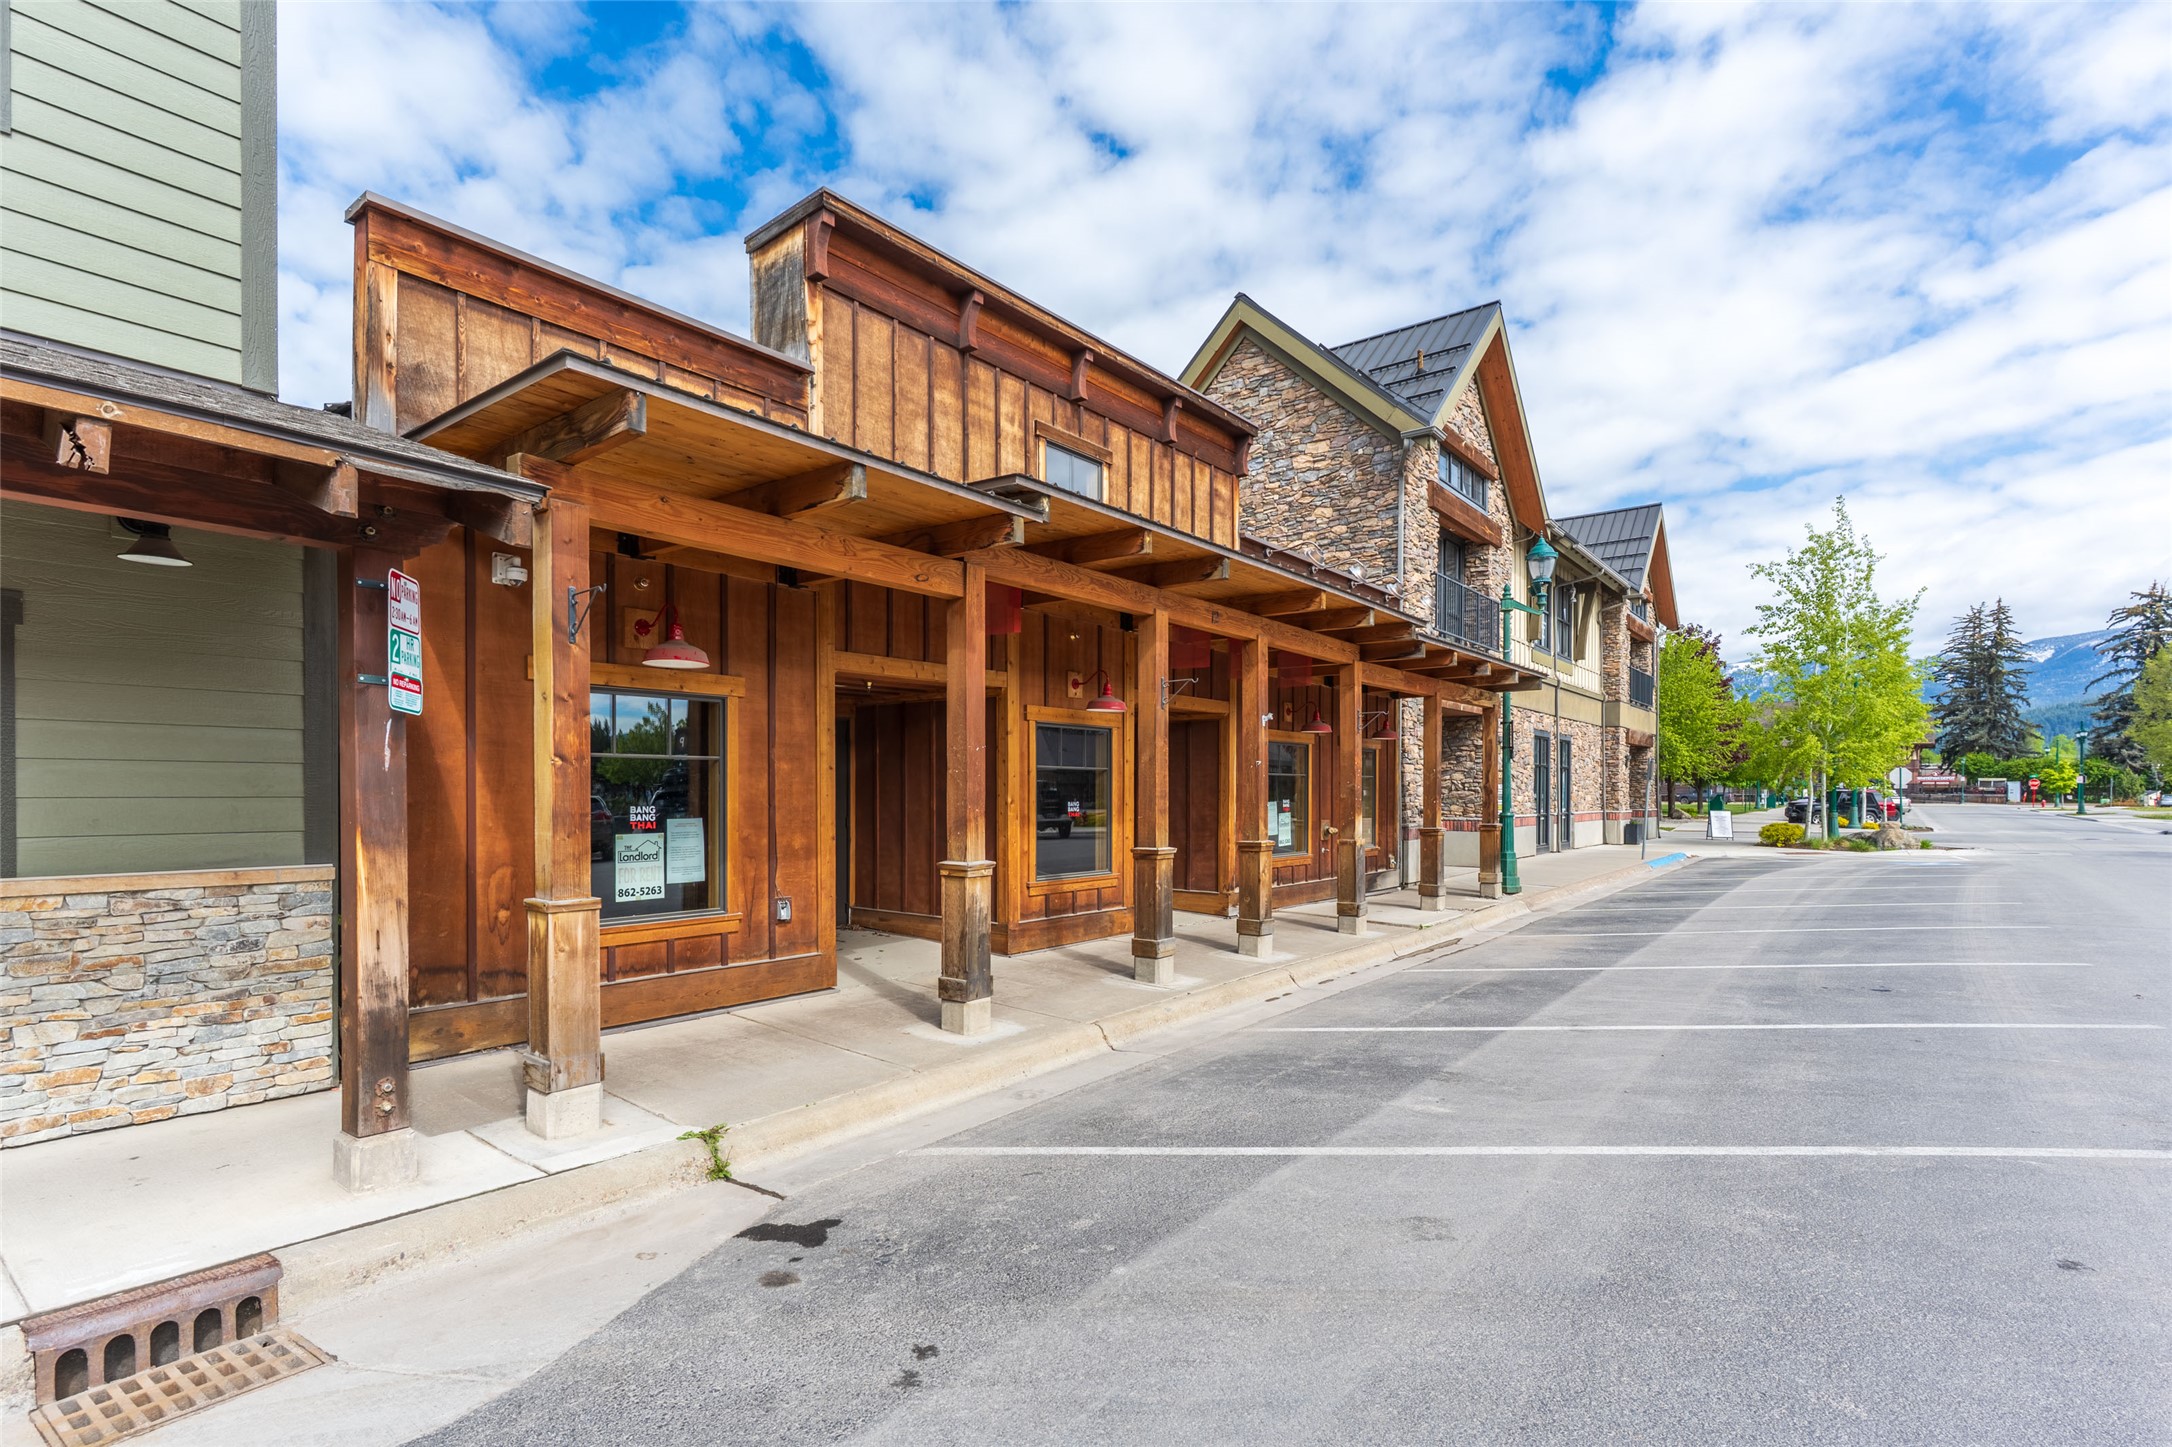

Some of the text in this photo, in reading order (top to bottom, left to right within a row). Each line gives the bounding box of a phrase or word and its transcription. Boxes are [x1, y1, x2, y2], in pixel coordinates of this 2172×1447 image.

[391, 577, 418, 605] NO PARKING
[392, 634, 400, 662] 2
[406, 636, 414, 651] HR
[401, 650, 419, 668] PARKING
[393, 678, 420, 692] NO REPARKING
[630, 806, 656, 814] BANG
[630, 814, 656, 822] BANG
[630, 821, 657, 830] THAI
[619, 851, 658, 862] Landlord
[618, 867, 636, 885] FOR
[639, 864, 662, 882] RENT
[617, 886, 662, 898] 862-5263
